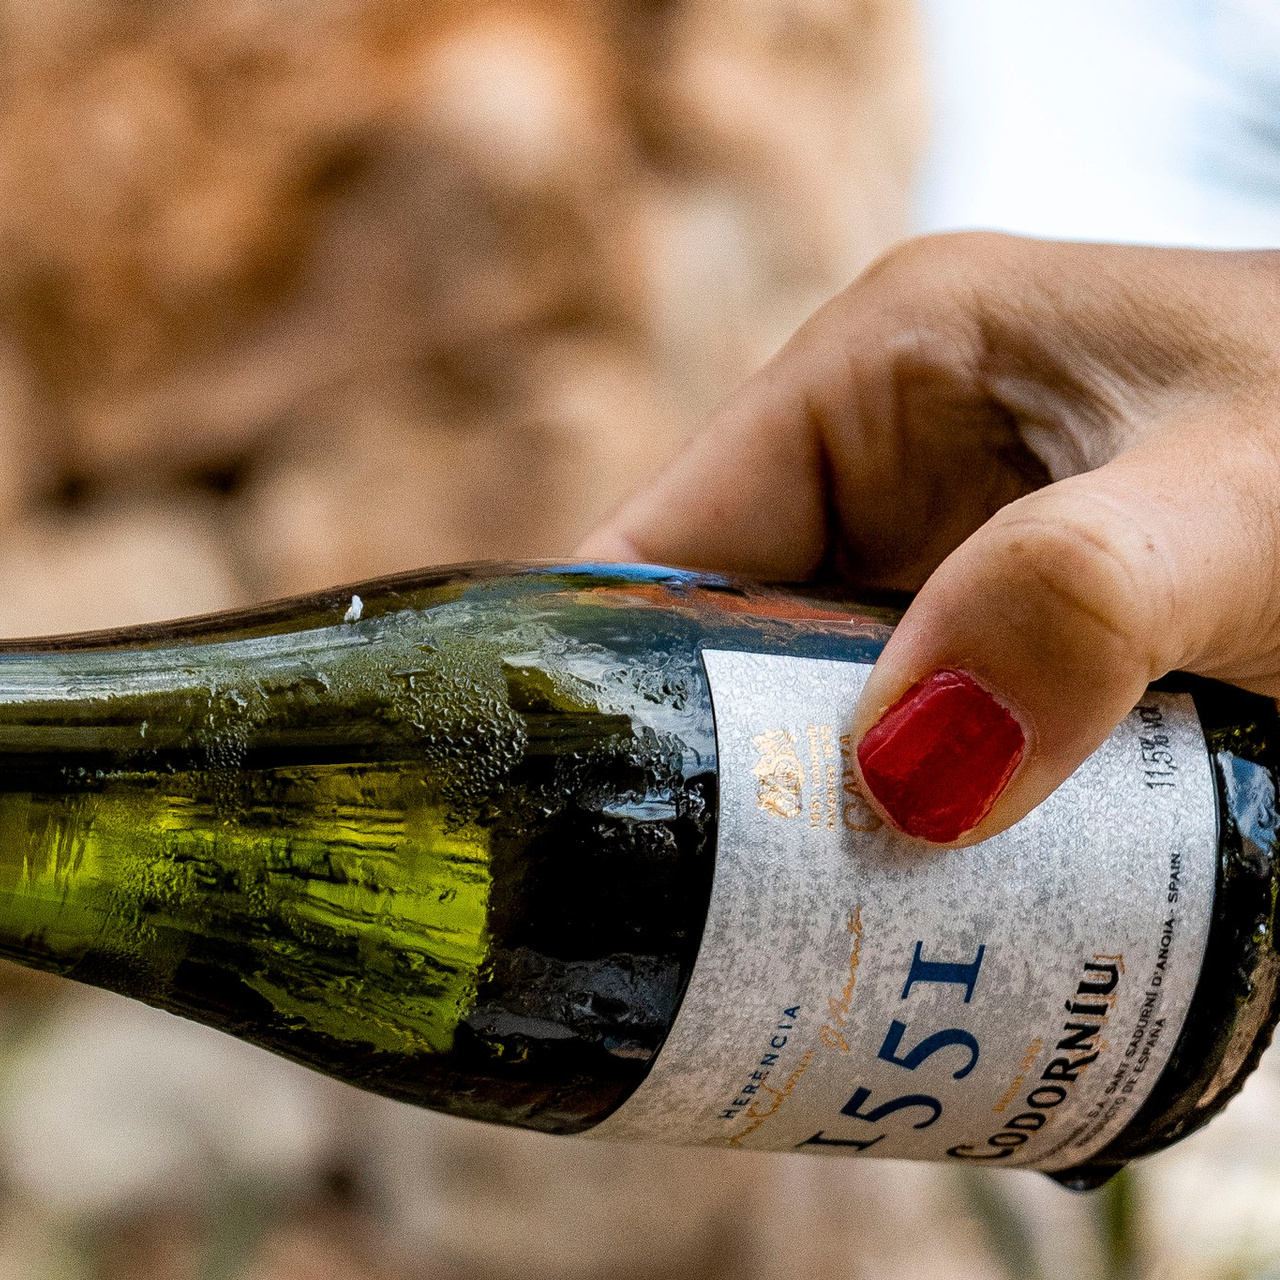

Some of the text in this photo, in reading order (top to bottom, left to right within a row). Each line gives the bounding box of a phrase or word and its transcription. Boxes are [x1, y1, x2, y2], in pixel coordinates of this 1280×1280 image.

[1138, 735, 1178, 790] 11,5%
[794, 940, 986, 1152] 1551
[946, 960, 1122, 1159] CODORNÍU
[1104, 1060, 1130, 1095] SANT
[1124, 991, 1159, 1058] SADURNÍ
[1151, 918, 1176, 987] D'ANOIA
[1168, 852, 1181, 903] SPAIN
[1122, 1076, 1140, 1093] DE
